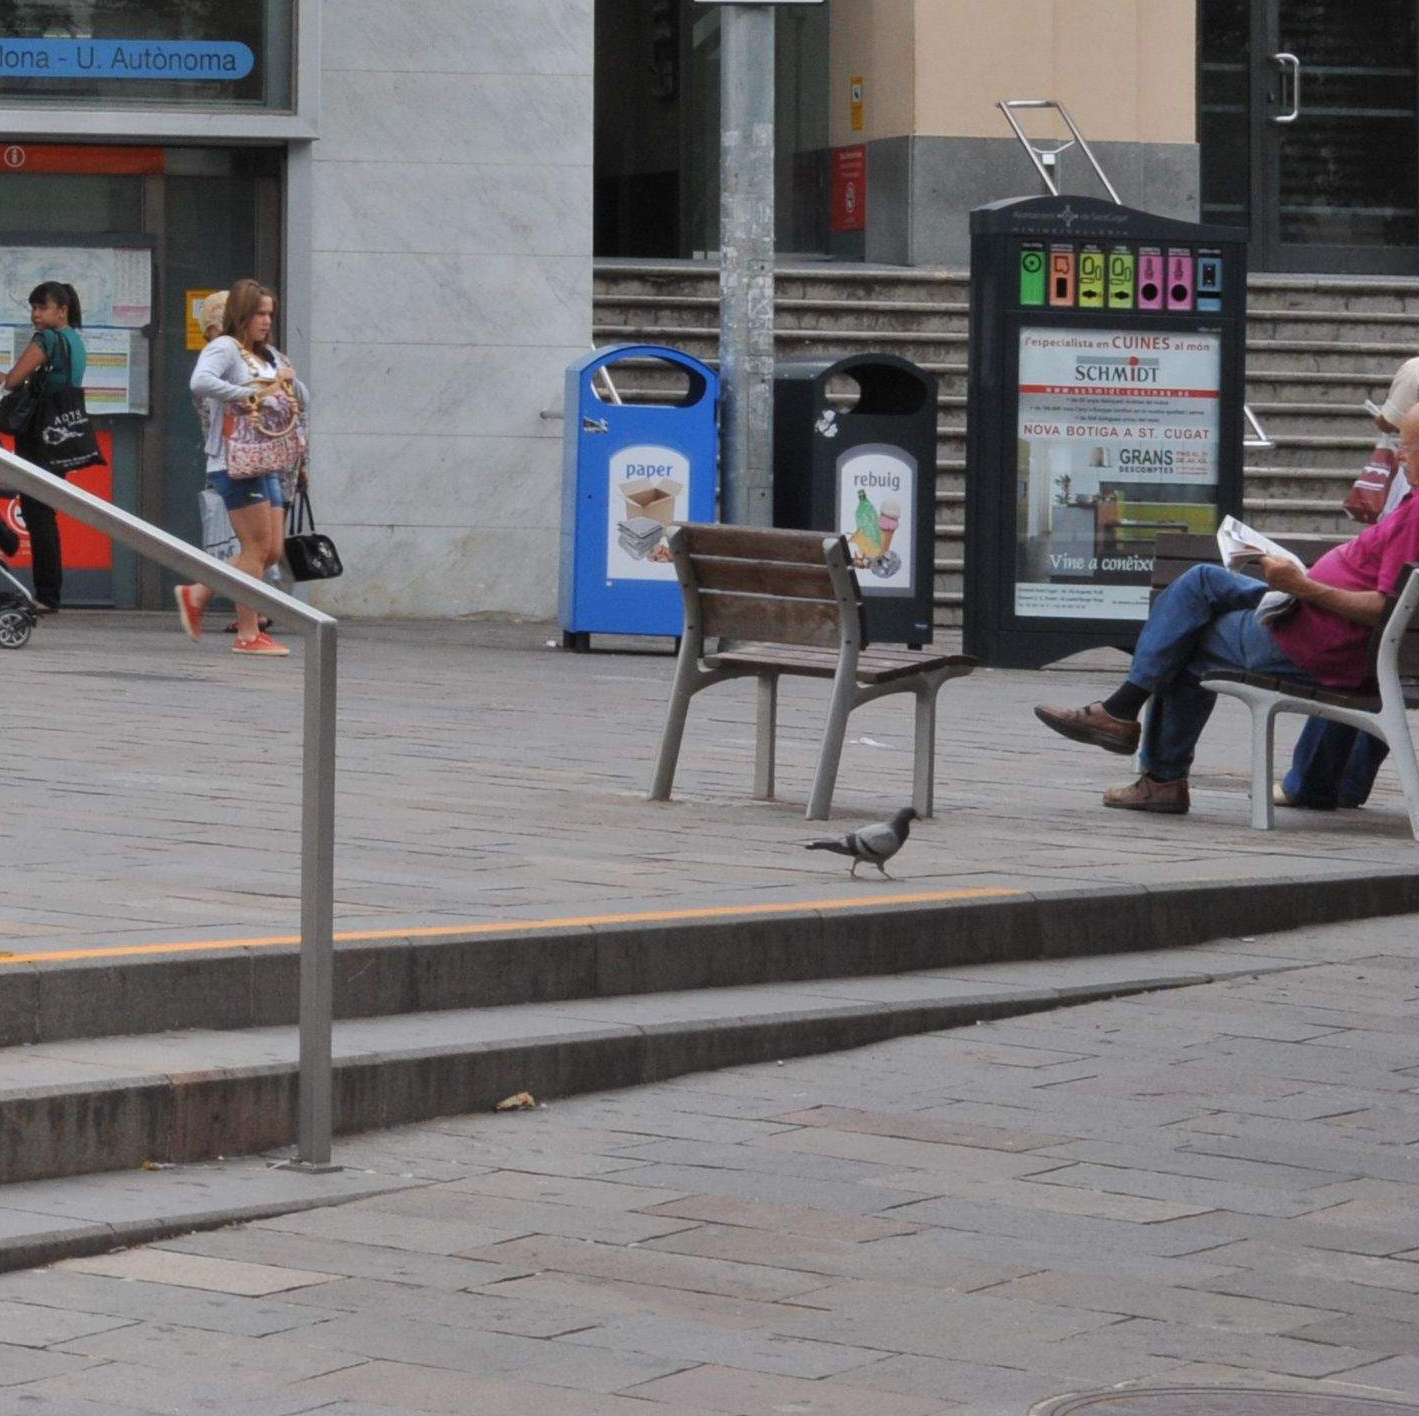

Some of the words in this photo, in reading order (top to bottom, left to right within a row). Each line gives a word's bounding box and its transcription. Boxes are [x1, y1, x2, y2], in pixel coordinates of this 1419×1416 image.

[76, 46, 102, 70] U.
[111, 46, 236, 71] Autònoma
[1096, 340, 1109, 348] en
[1112, 336, 1171, 351] CUINES
[1174, 342, 1184, 351] al
[1186, 342, 1210, 352] món
[1075, 360, 1160, 383] SCHMIDT
[1024, 424, 1061, 436] NOVA
[1066, 425, 1119, 438] BOTIGA
[1124, 427, 1133, 438] A
[1138, 427, 1157, 439] ST.
[1164, 428, 1210, 440] CUGAT
[1120, 449, 1174, 466] GRANS
[626, 464, 674, 480] paper
[1119, 466, 1174, 474] DESCOMPTES
[853, 470, 901, 492] rebuig
[1049, 552, 1084, 570] Vine
[1087, 557, 1098, 570] a
